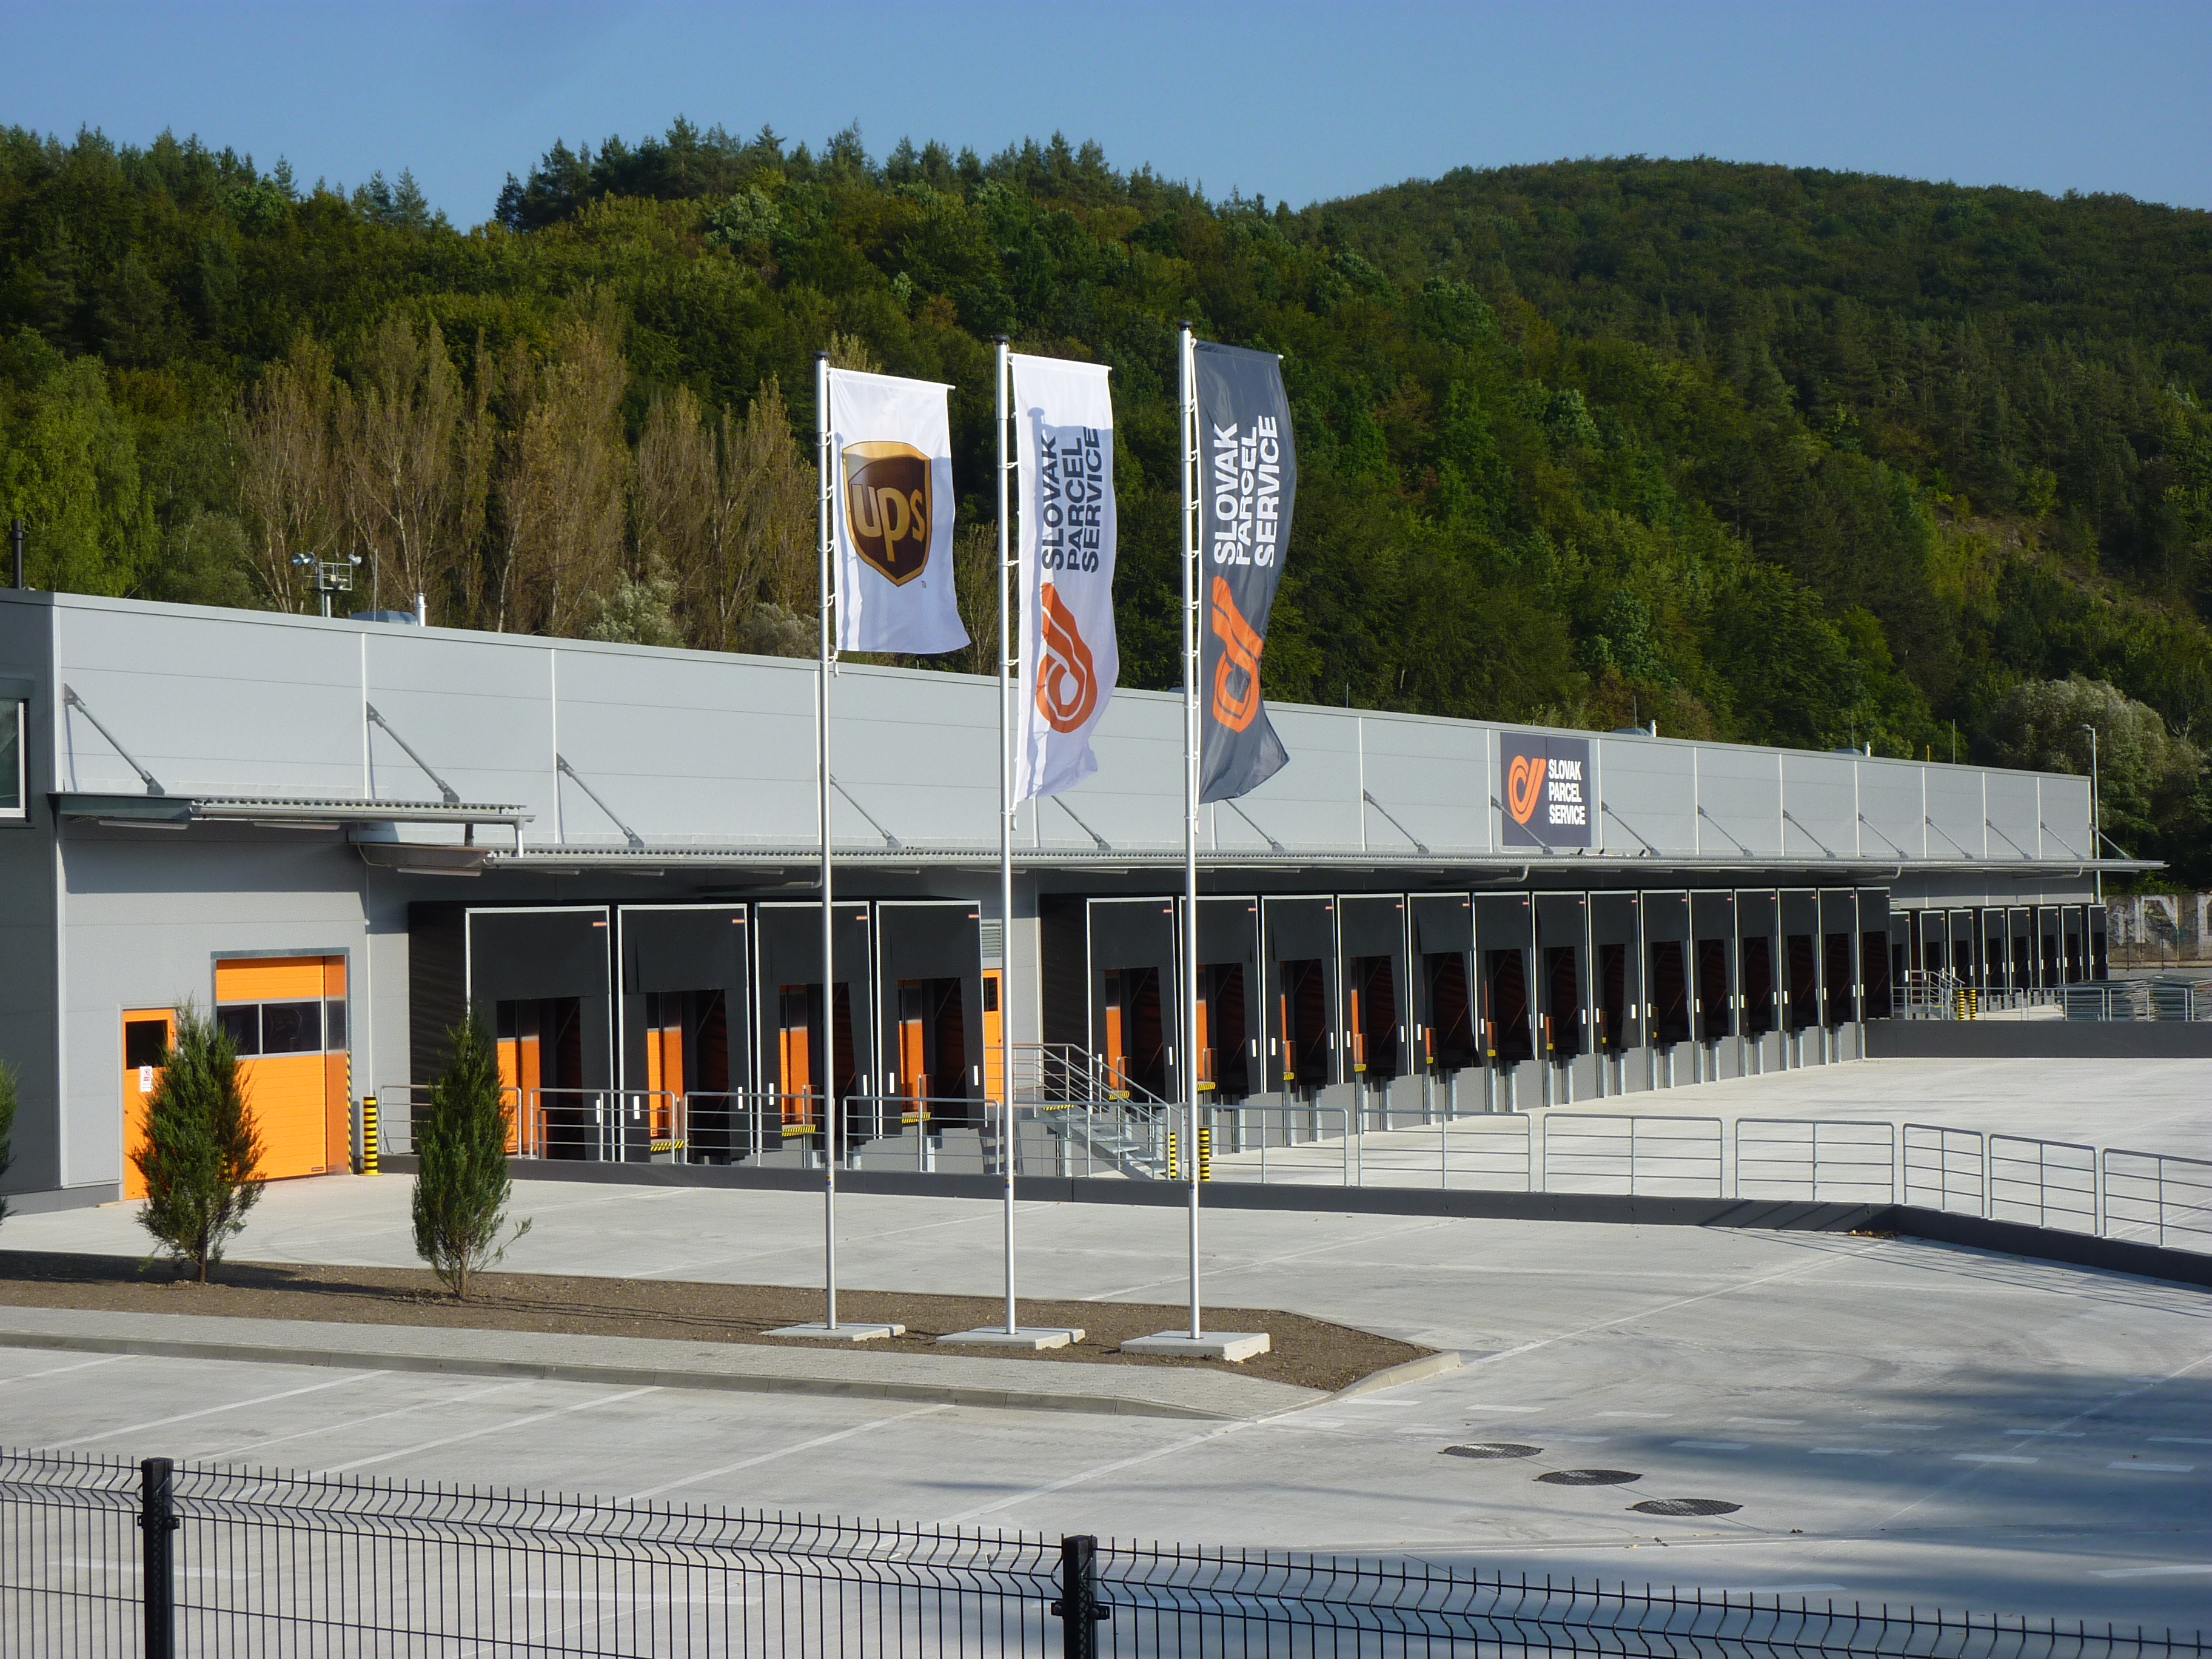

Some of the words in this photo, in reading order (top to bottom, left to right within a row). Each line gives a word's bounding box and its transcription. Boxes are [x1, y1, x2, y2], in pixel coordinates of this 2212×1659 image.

[851, 484, 926, 563] ups
[1041, 435, 1064, 571] SLOVAK
[1061, 437, 1085, 571] PARCEL
[1082, 426, 1102, 573] SERVICE
[1213, 423, 1239, 565] SLOVAK
[1236, 426, 1258, 565] PARCEL
[1255, 415, 1280, 568] SERVICE
[1548, 759, 1582, 780] SLOVAK
[1549, 782, 1583, 803] PARCEL
[1549, 804, 1586, 825] SERVICE
